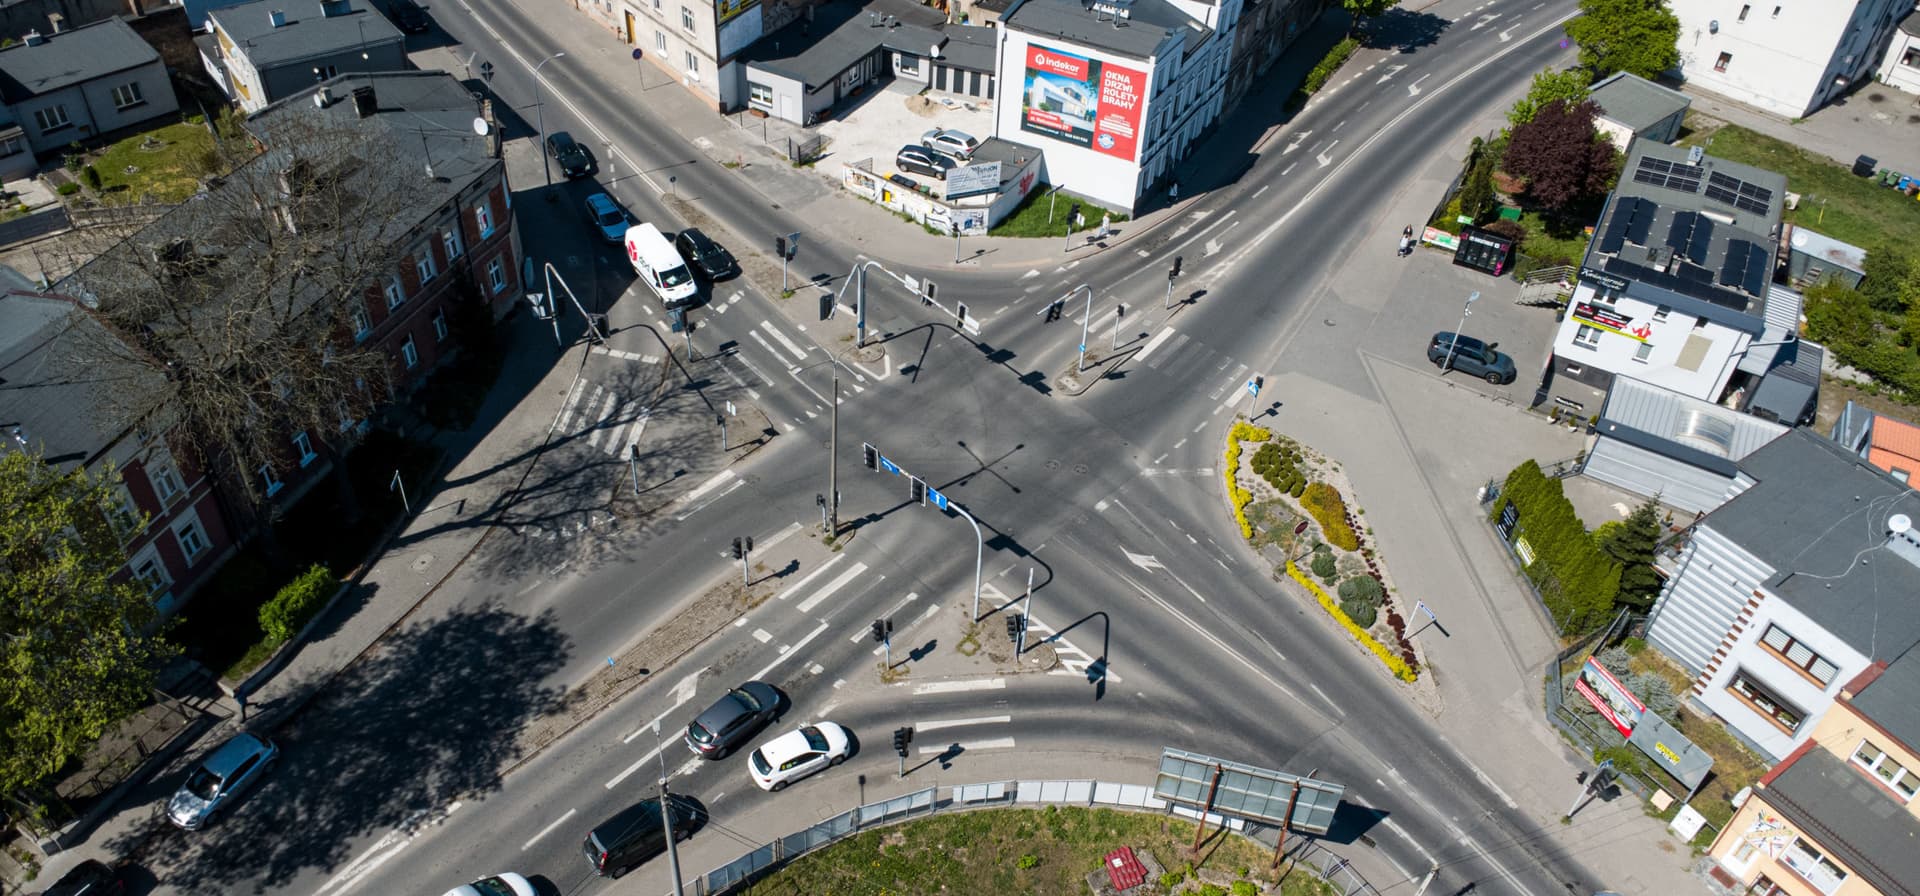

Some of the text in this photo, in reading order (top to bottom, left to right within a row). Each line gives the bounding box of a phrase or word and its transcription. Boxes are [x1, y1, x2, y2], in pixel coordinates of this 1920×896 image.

[1105, 71, 1130, 83] OKNA
[1104, 79, 1133, 92] DRZWI
[1103, 87, 1138, 101] ROLETY
[1102, 95, 1134, 110] BRAMY
